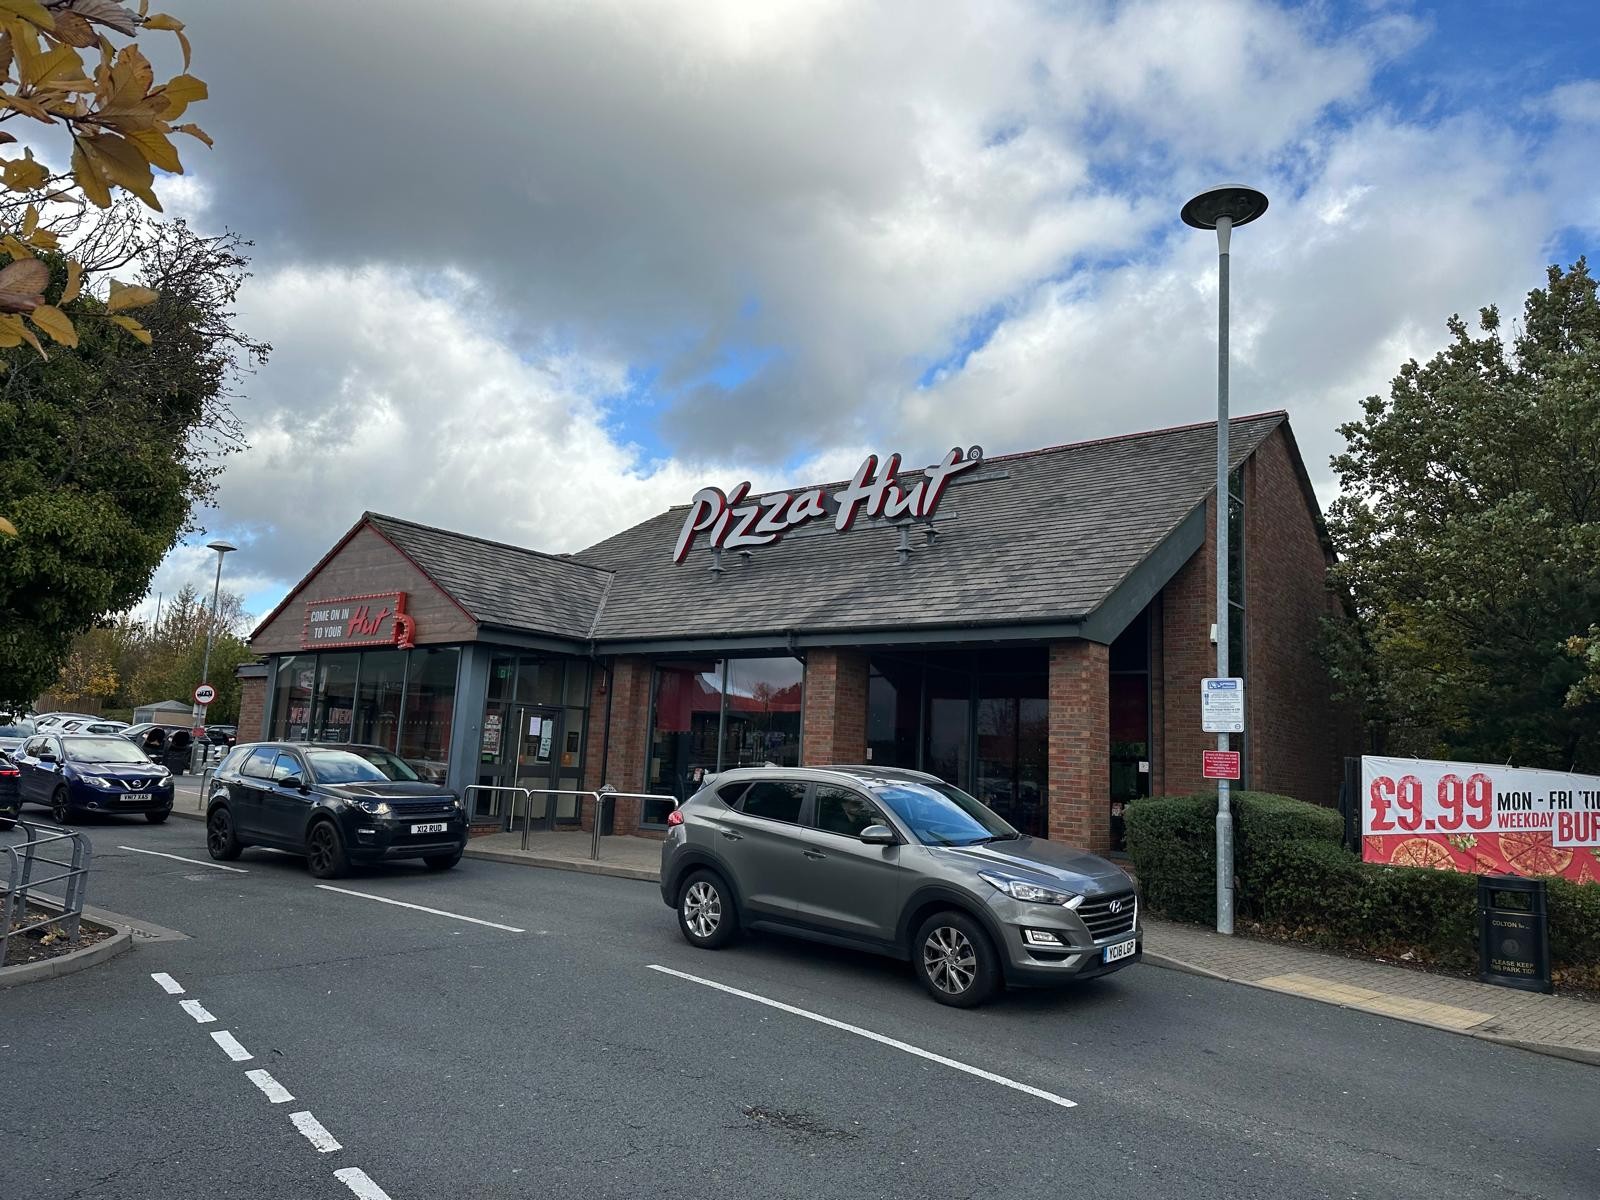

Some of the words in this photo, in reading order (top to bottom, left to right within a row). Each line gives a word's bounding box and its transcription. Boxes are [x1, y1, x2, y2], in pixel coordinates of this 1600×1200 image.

[673, 481, 826, 565] Pizza
[311, 610, 329, 622] COME
[331, 609, 340, 620] ON
[341, 608, 350, 619] IN
[347, 605, 392, 638] Hut
[314, 627, 322, 638] TO
[324, 626, 342, 637] YOUR
[1371, 773, 1492, 831] £9.99
[1497, 792, 1532, 811] MON
[1550, 791, 1572, 809] FRI
[429, 824, 442, 832] RUD
[1497, 812, 1554, 828] WEEKDAY
[1492, 919, 1517, 928] COLTON
